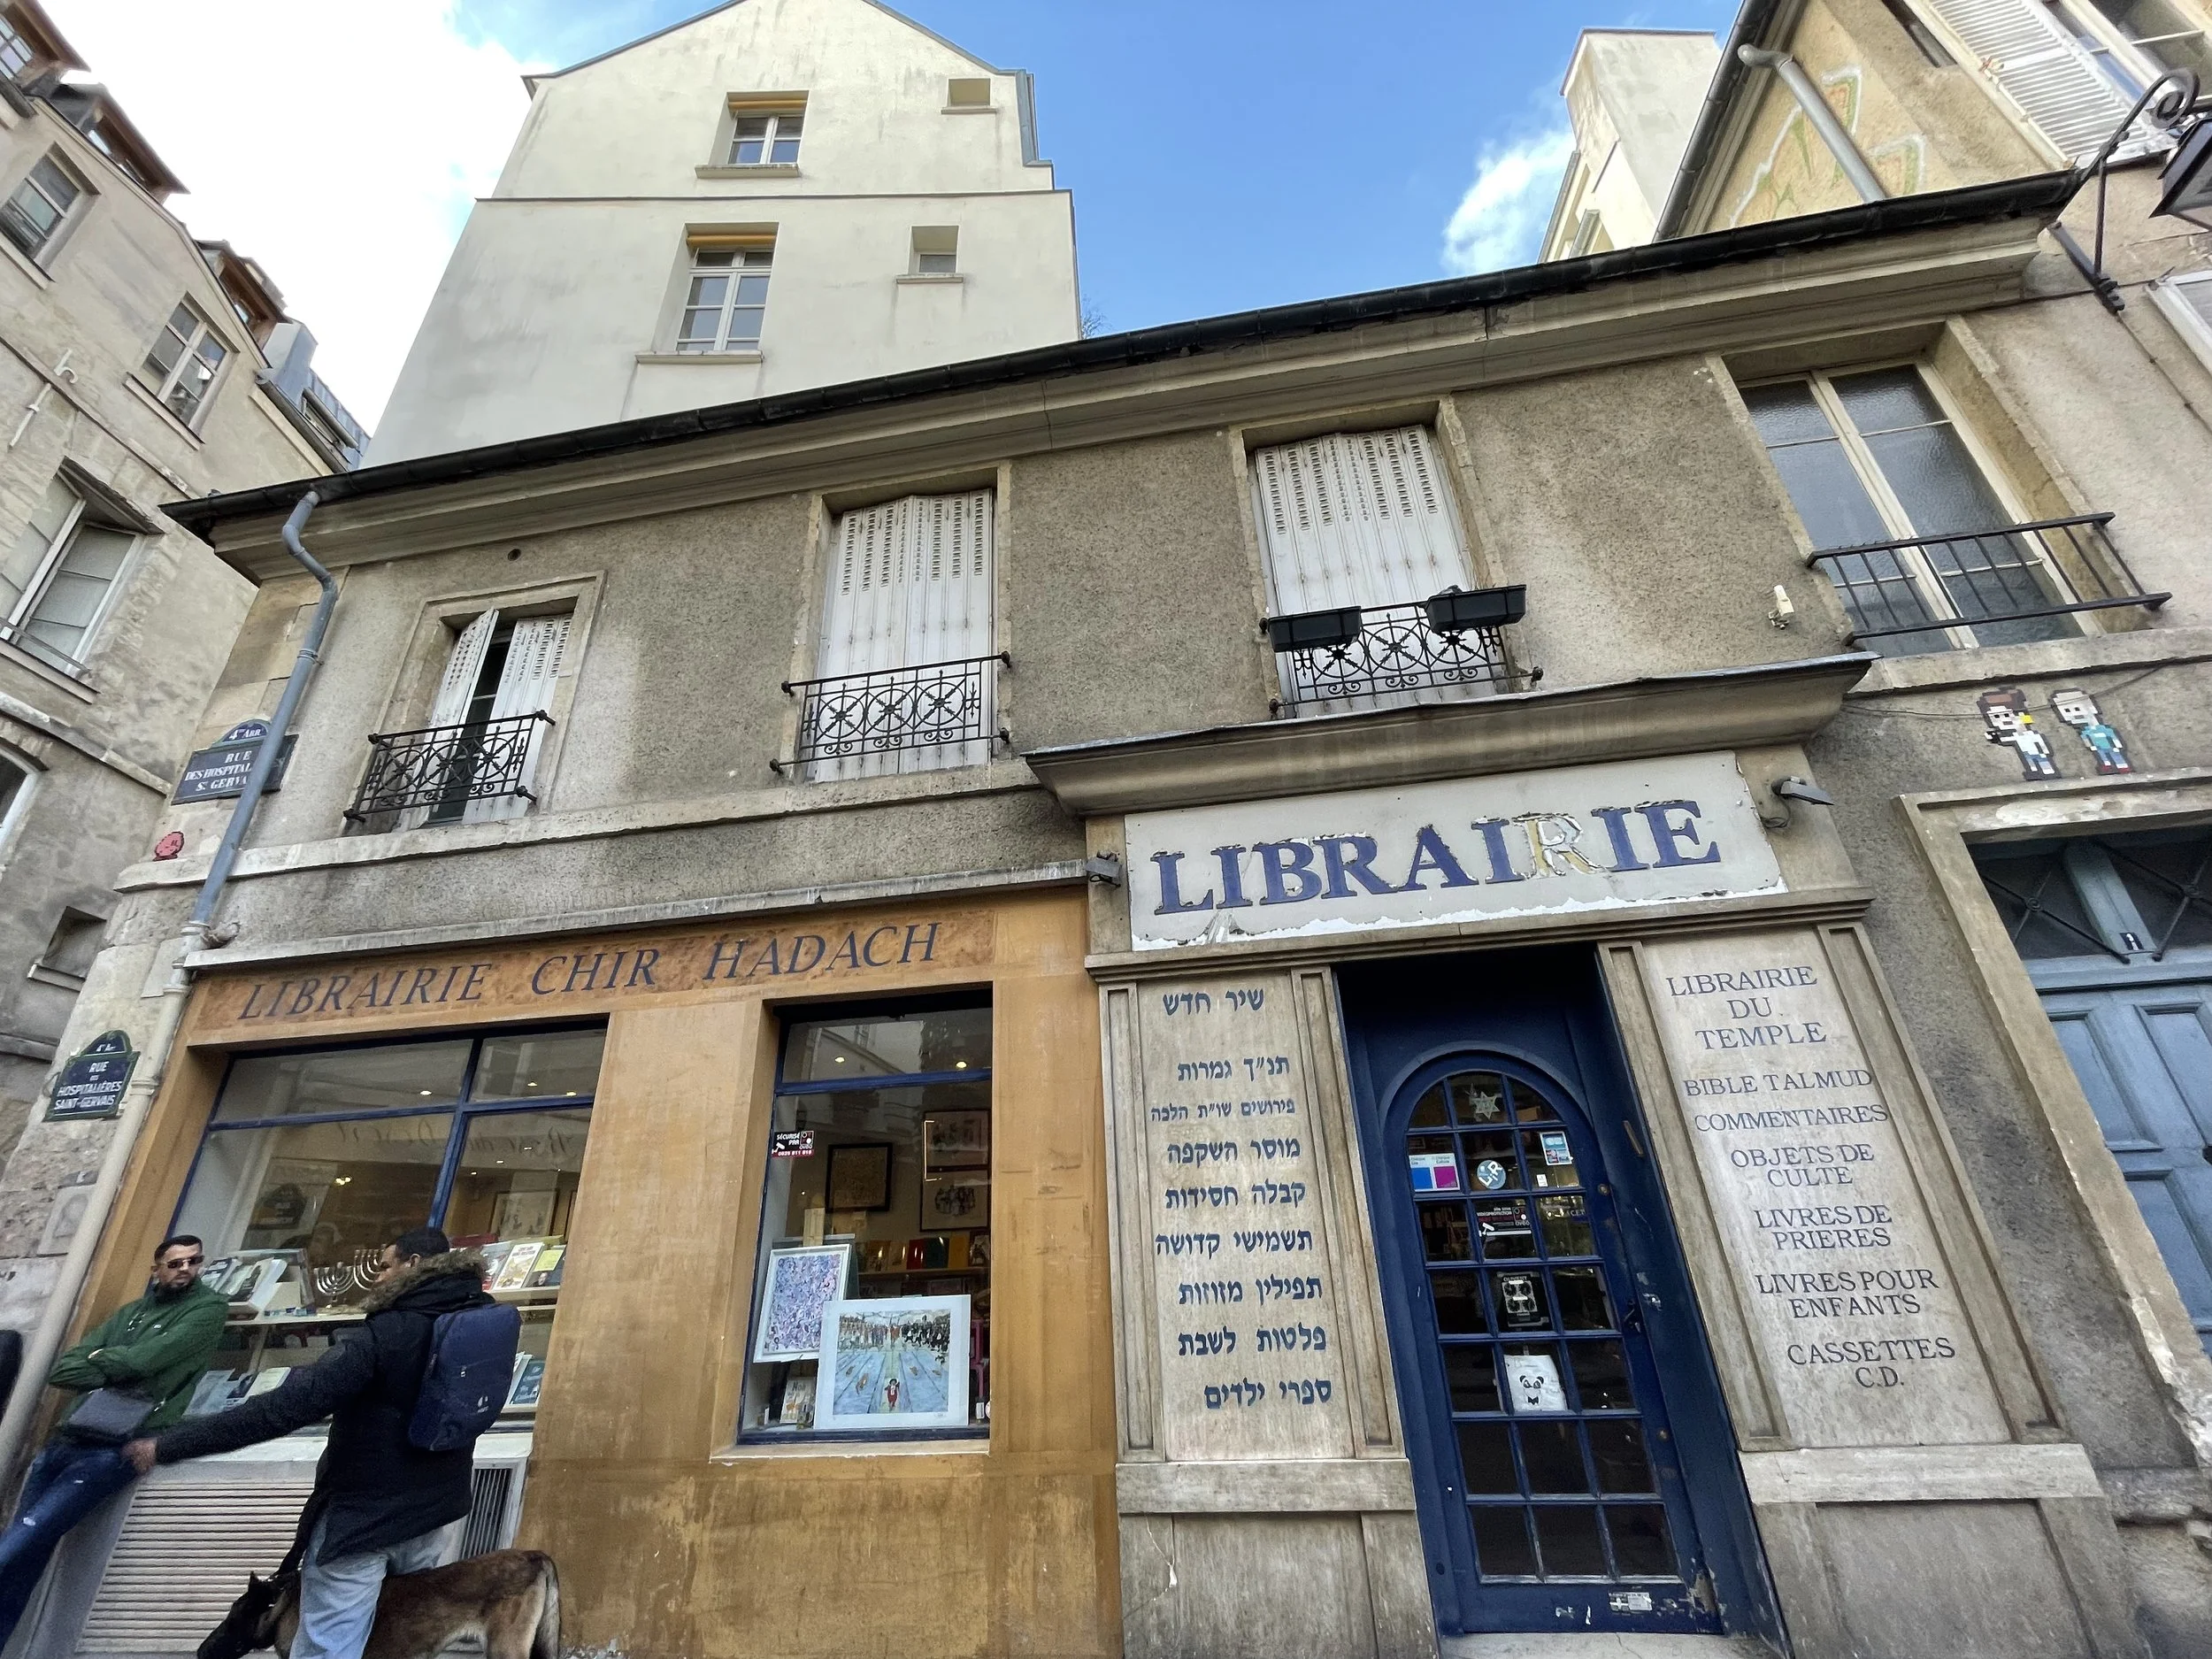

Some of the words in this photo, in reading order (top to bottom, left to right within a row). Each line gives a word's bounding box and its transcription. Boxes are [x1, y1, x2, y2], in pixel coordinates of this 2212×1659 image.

[225, 750, 252, 764] RUE
[185, 769, 204, 781] DES
[204, 763, 252, 779] HOSPITAL
[211, 775, 248, 789] GERVA
[1151, 800, 1721, 916] LIBRAIRIE
[238, 964, 493, 1020] LIBRAIRIE
[531, 948, 660, 995] CHIR
[703, 922, 942, 980] HADACH
[1666, 965, 1817, 997] LIBRAIRIE
[1163, 991, 1211, 1016] חדש
[1225, 987, 1264, 1011] שיר
[1727, 996, 1773, 1019] DU
[1695, 1022, 1827, 1050] TEMPLE
[89, 1061, 110, 1073] RUE
[1178, 1059, 1233, 1082] גמרות
[1684, 1075, 1758, 1097] BIBLE
[1763, 1069, 1872, 1091] TALMUD
[53, 1094, 116, 1110] SAINT-GERVAIS
[1151, 1102, 1189, 1122] הלכה
[1240, 1097, 1295, 1117] פירושים
[1694, 1103, 1889, 1132] COMMENTAIRES
[1167, 1141, 1238, 1168] השקפה
[1250, 1138, 1301, 1159] מוסר
[1731, 1145, 1836, 1168] OBJETS
[1840, 1143, 1875, 1163] DE
[1767, 1166, 1854, 1187] CULTE
[1165, 1186, 1239, 1210] חסידות
[1251, 1178, 1306, 1209] קבלה
[1754, 1206, 1852, 1229] LIVRES
[1854, 1204, 1893, 1225] DE
[1156, 1232, 1220, 1260] קדושה
[1233, 1229, 1313, 1253] תשמישי
[1773, 1227, 1892, 1250] PRIERES
[1179, 1280, 1243, 1305] מזוזות
[1256, 1273, 1323, 1306] תפילין
[1755, 1272, 1856, 1294] LIVRES
[1857, 1269, 1939, 1290] POUR
[1789, 1294, 1921, 1319] ENFANTS
[1178, 1325, 1236, 1356] לשבת
[1256, 1322, 1326, 1352] פלטות
[1787, 1337, 1956, 1366] CASSETTES
[1855, 1367, 1905, 1389] C.D.
[1204, 1377, 1265, 1409] ילדים
[1279, 1379, 1332, 1405] ספרי
